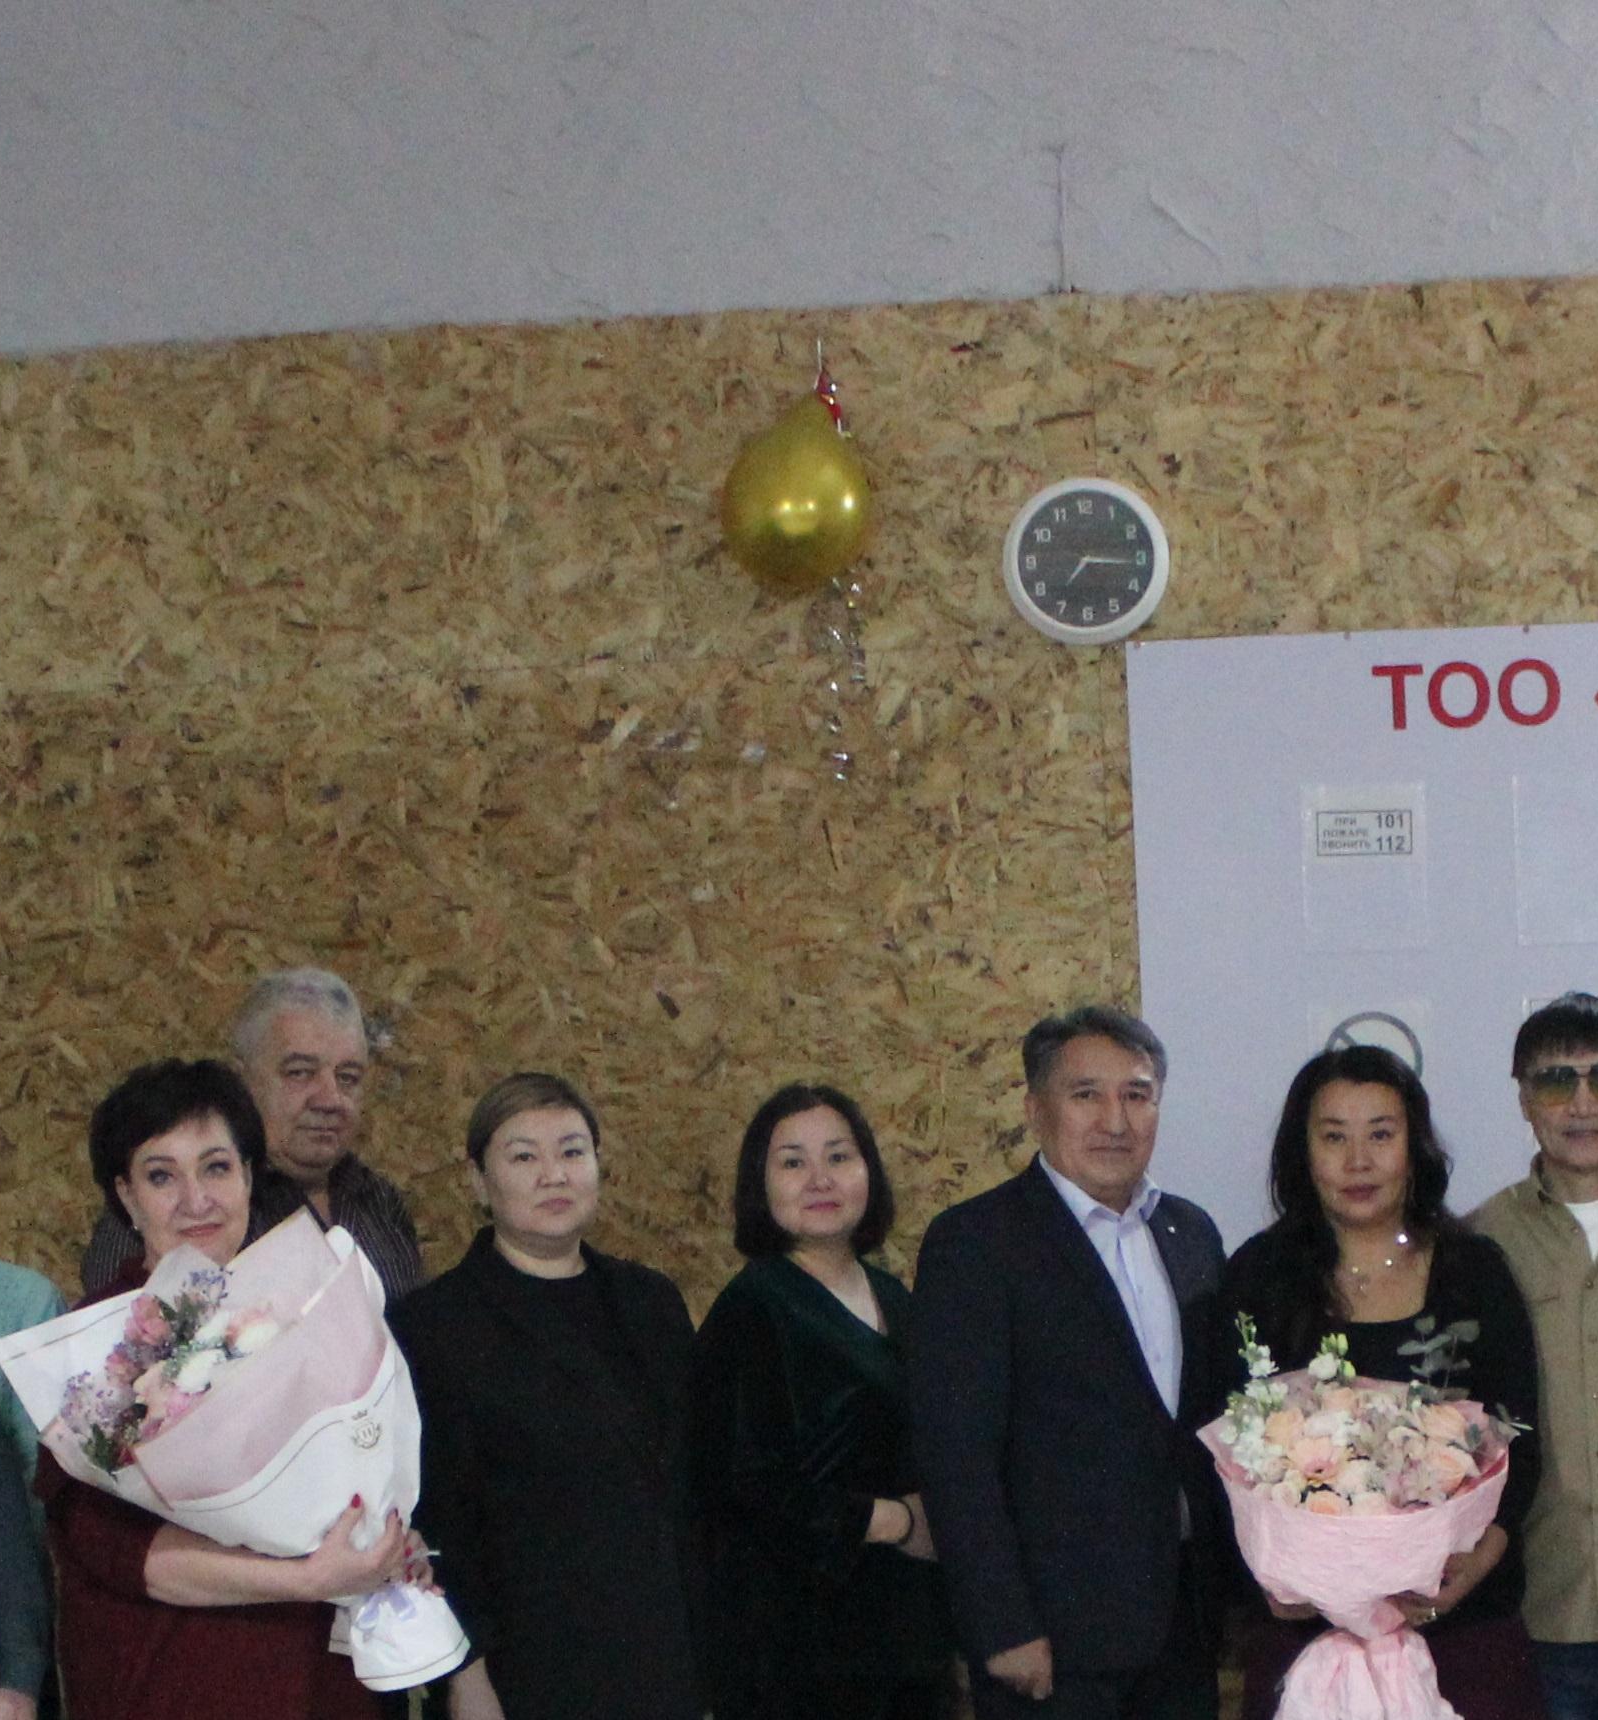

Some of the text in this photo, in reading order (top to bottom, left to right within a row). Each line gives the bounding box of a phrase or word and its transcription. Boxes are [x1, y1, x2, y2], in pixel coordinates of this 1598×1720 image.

[1053, 507, 1067, 522] 11
[1076, 499, 1093, 515] 12
[1108, 505, 1115, 520] 1
[1033, 527, 1052, 543] 10
[1126, 524, 1136, 538] 2
[1025, 555, 1037, 570] 9
[1136, 551, 1147, 566] 3
[1036, 582, 1046, 596] 8
[1128, 578, 1139, 592] 4
[1056, 600, 1068, 615] 7
[1082, 606, 1093, 620] 6
[1109, 599, 1119, 613] 5
[1371, 658, 1562, 731] ТОО
[1335, 816, 1357, 825] ПРИ
[1377, 813, 1404, 828] 101
[1376, 836, 1405, 851] 112
